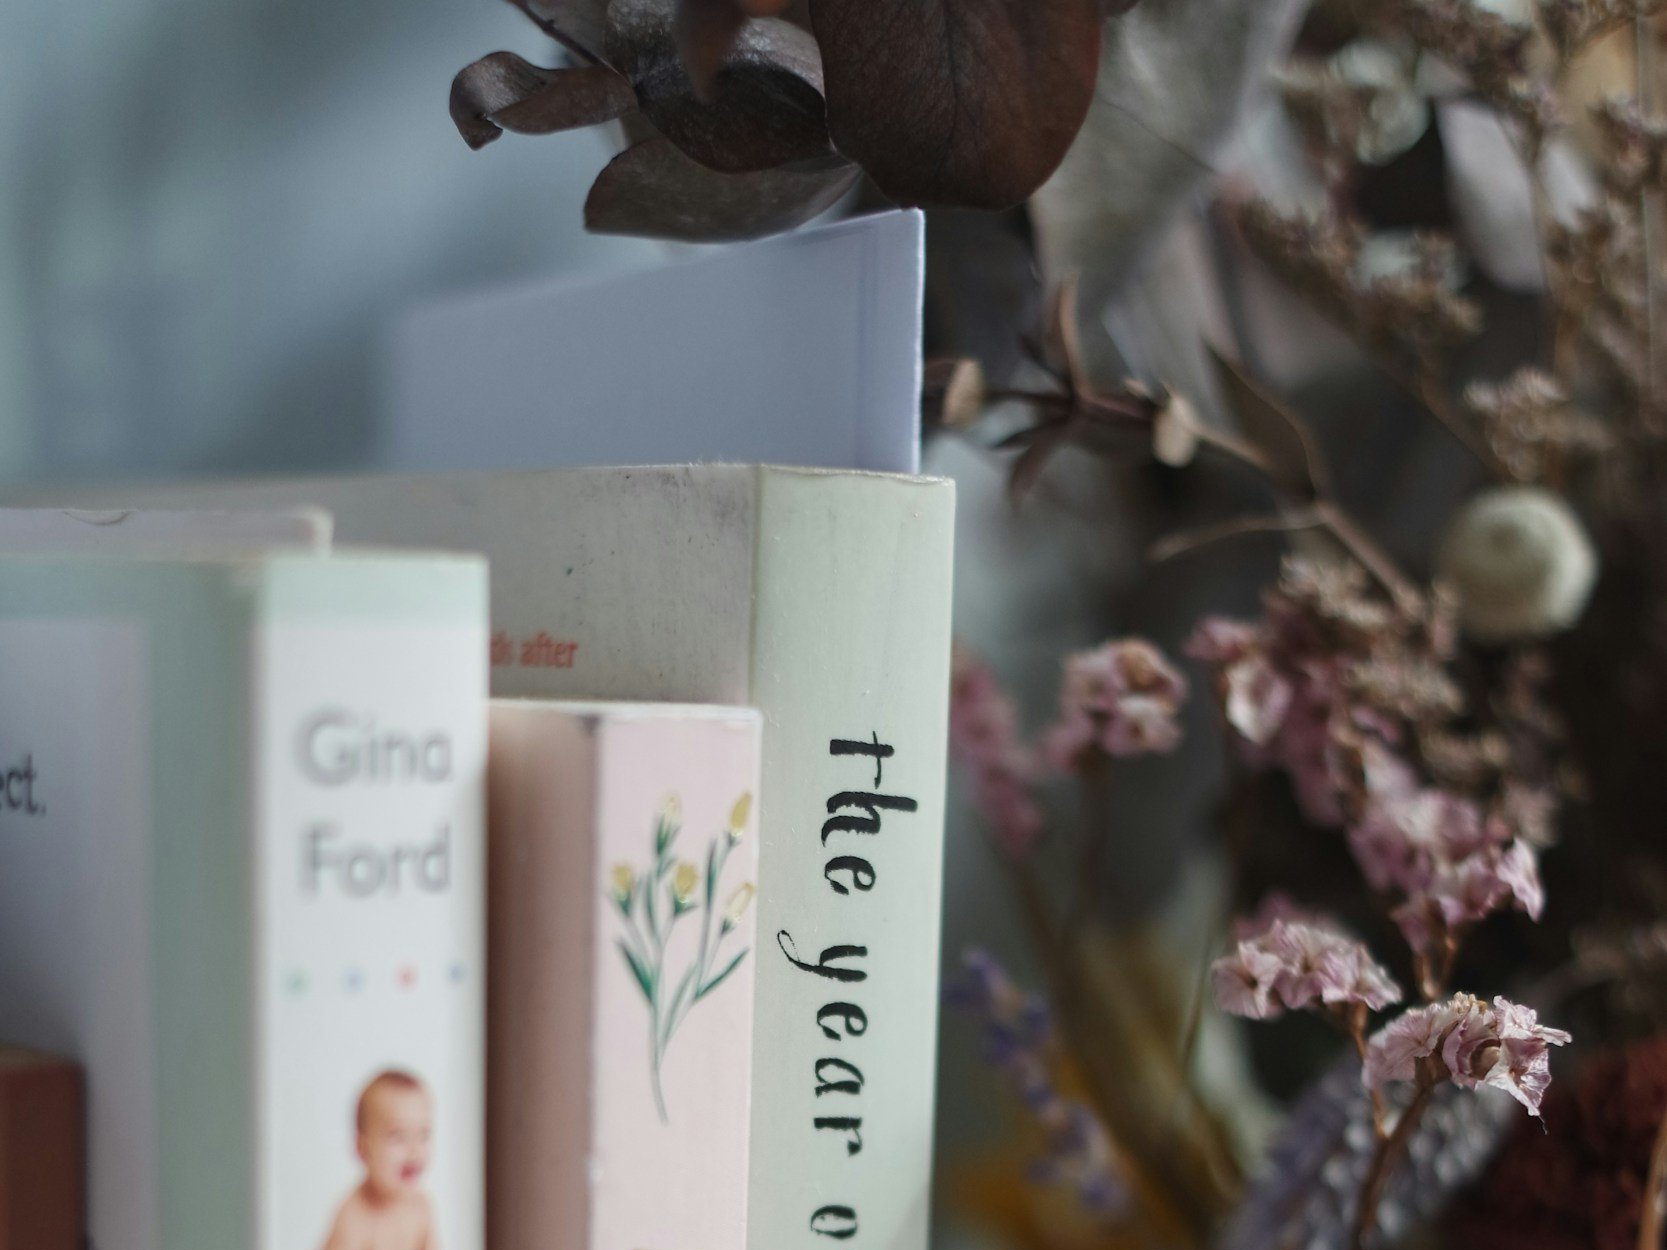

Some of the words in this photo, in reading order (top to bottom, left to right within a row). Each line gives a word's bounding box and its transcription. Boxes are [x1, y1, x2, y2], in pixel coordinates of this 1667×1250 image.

[521, 631, 578, 669] after
[293, 706, 453, 787] Gina
[821, 731, 918, 896] the
[302, 822, 452, 896] Ford
[777, 930, 869, 1157] year
